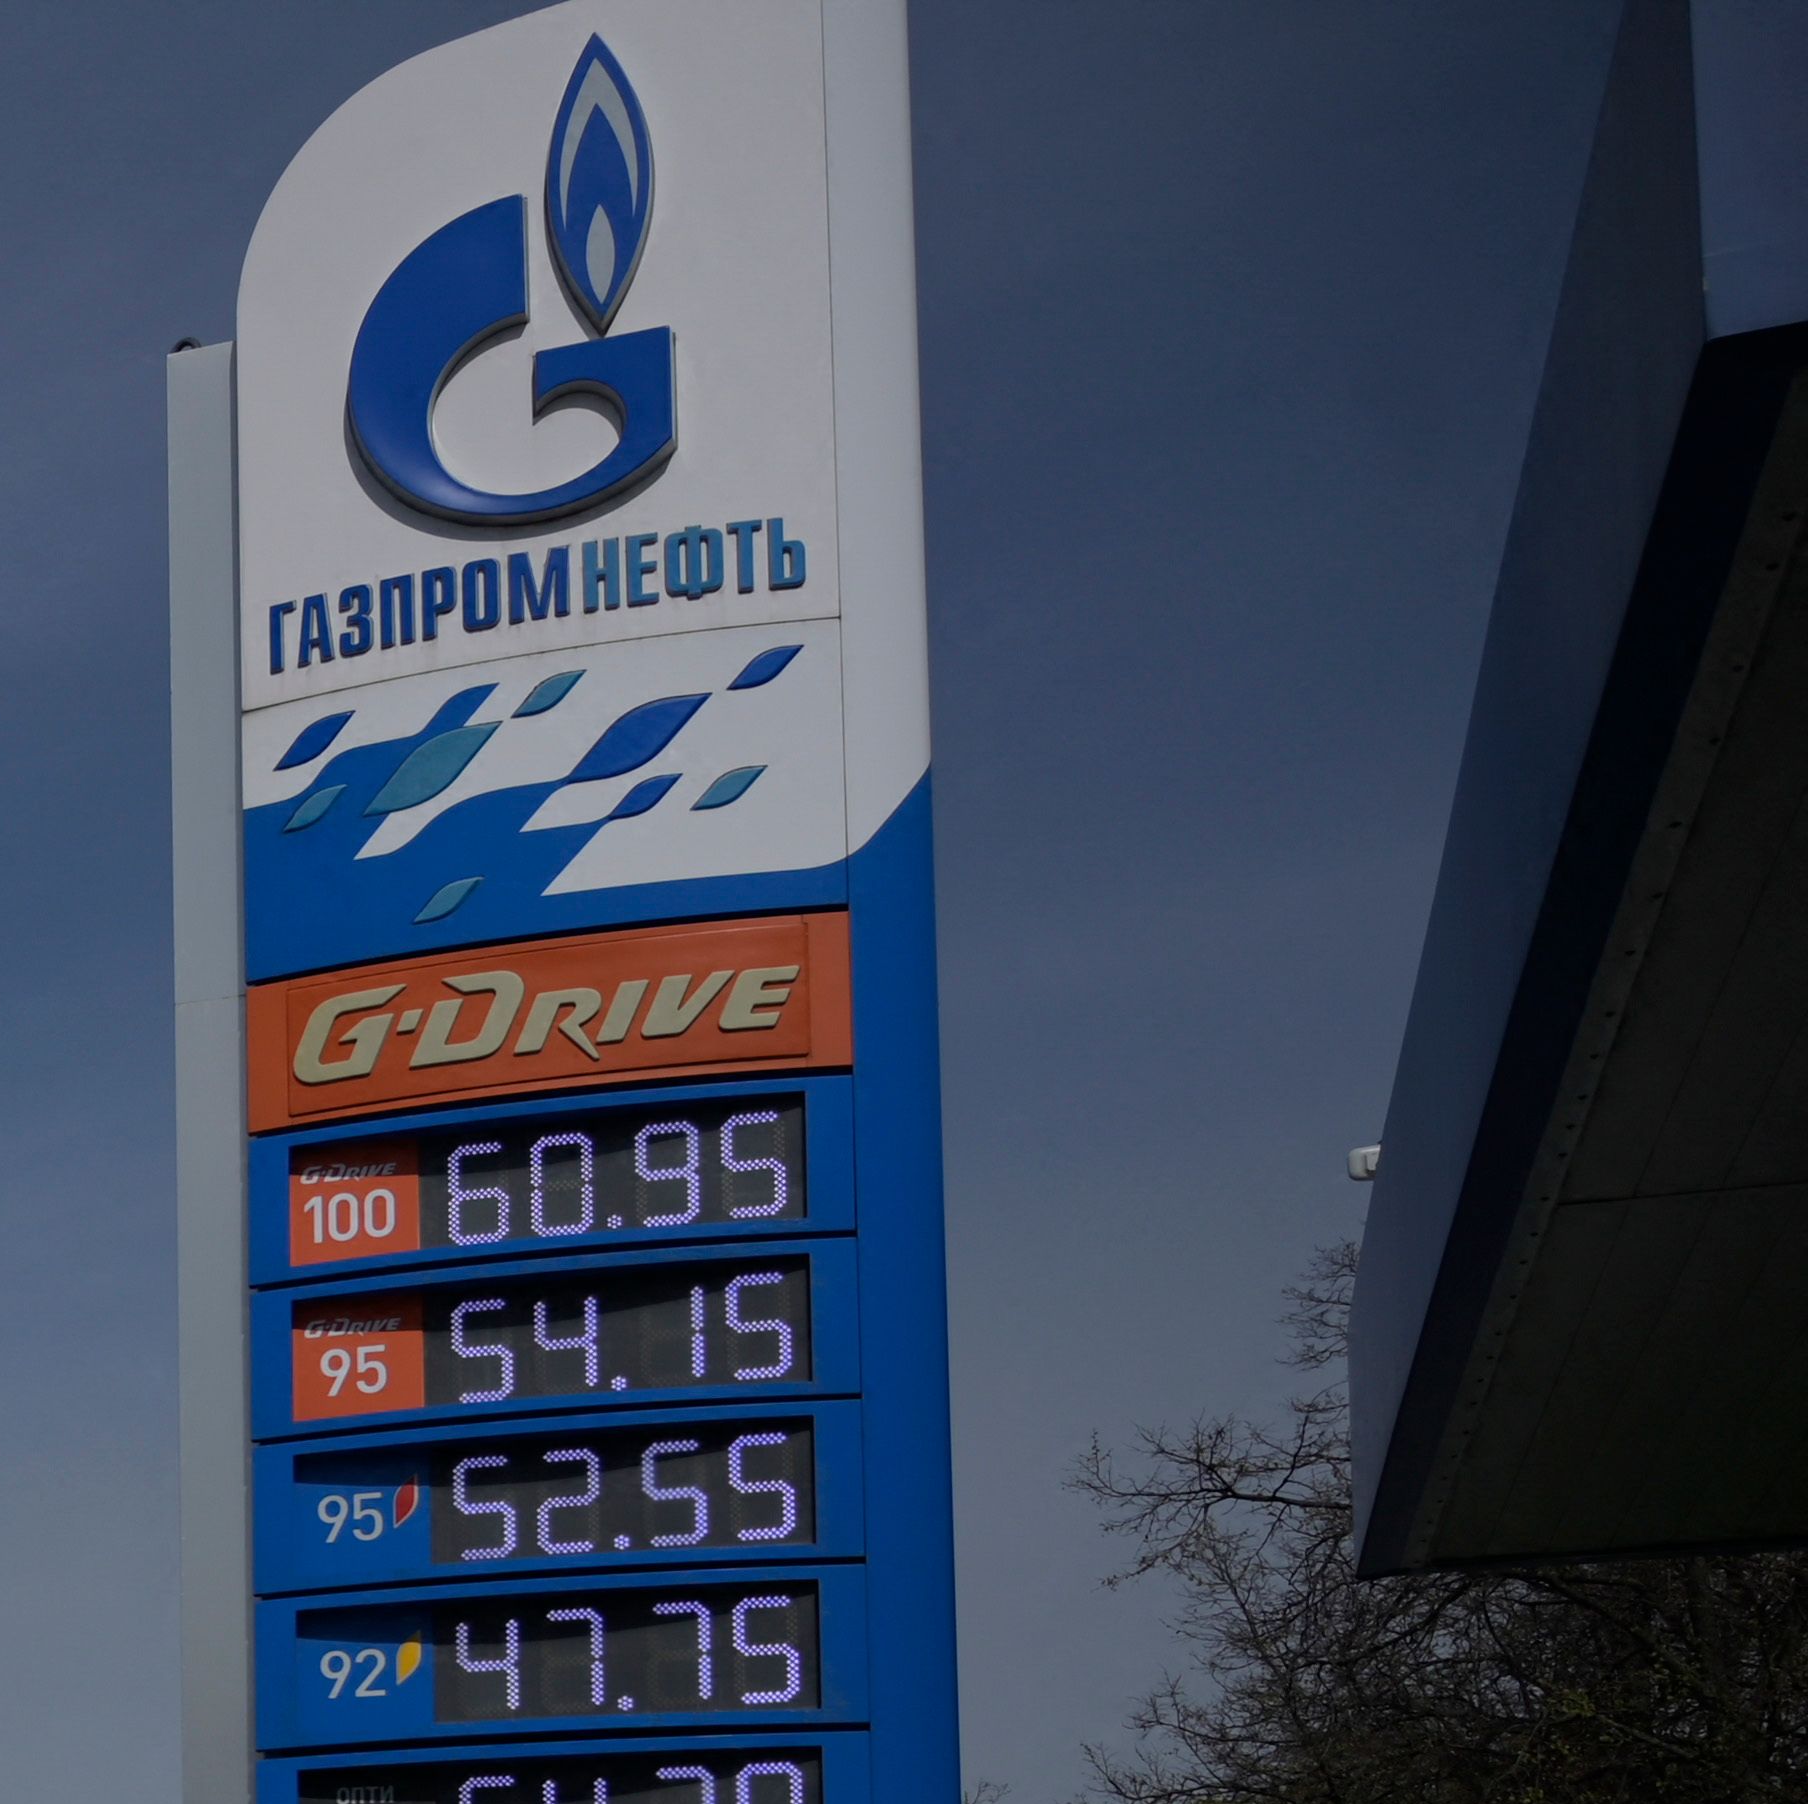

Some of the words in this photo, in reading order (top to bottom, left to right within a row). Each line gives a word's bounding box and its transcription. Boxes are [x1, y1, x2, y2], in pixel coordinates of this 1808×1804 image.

[268, 517, 806, 675] ГАЗПРОМНЕФТЬ
[303, 1188, 396, 1244] 100
[447, 1110, 787, 1246] 60.95
[319, 1343, 388, 1398] 95
[449, 1270, 793, 1405] 54.15
[316, 1491, 384, 1544] 95
[452, 1431, 796, 1562] 52.55
[319, 1647, 387, 1700] 92
[455, 1593, 801, 1711] 47.75
